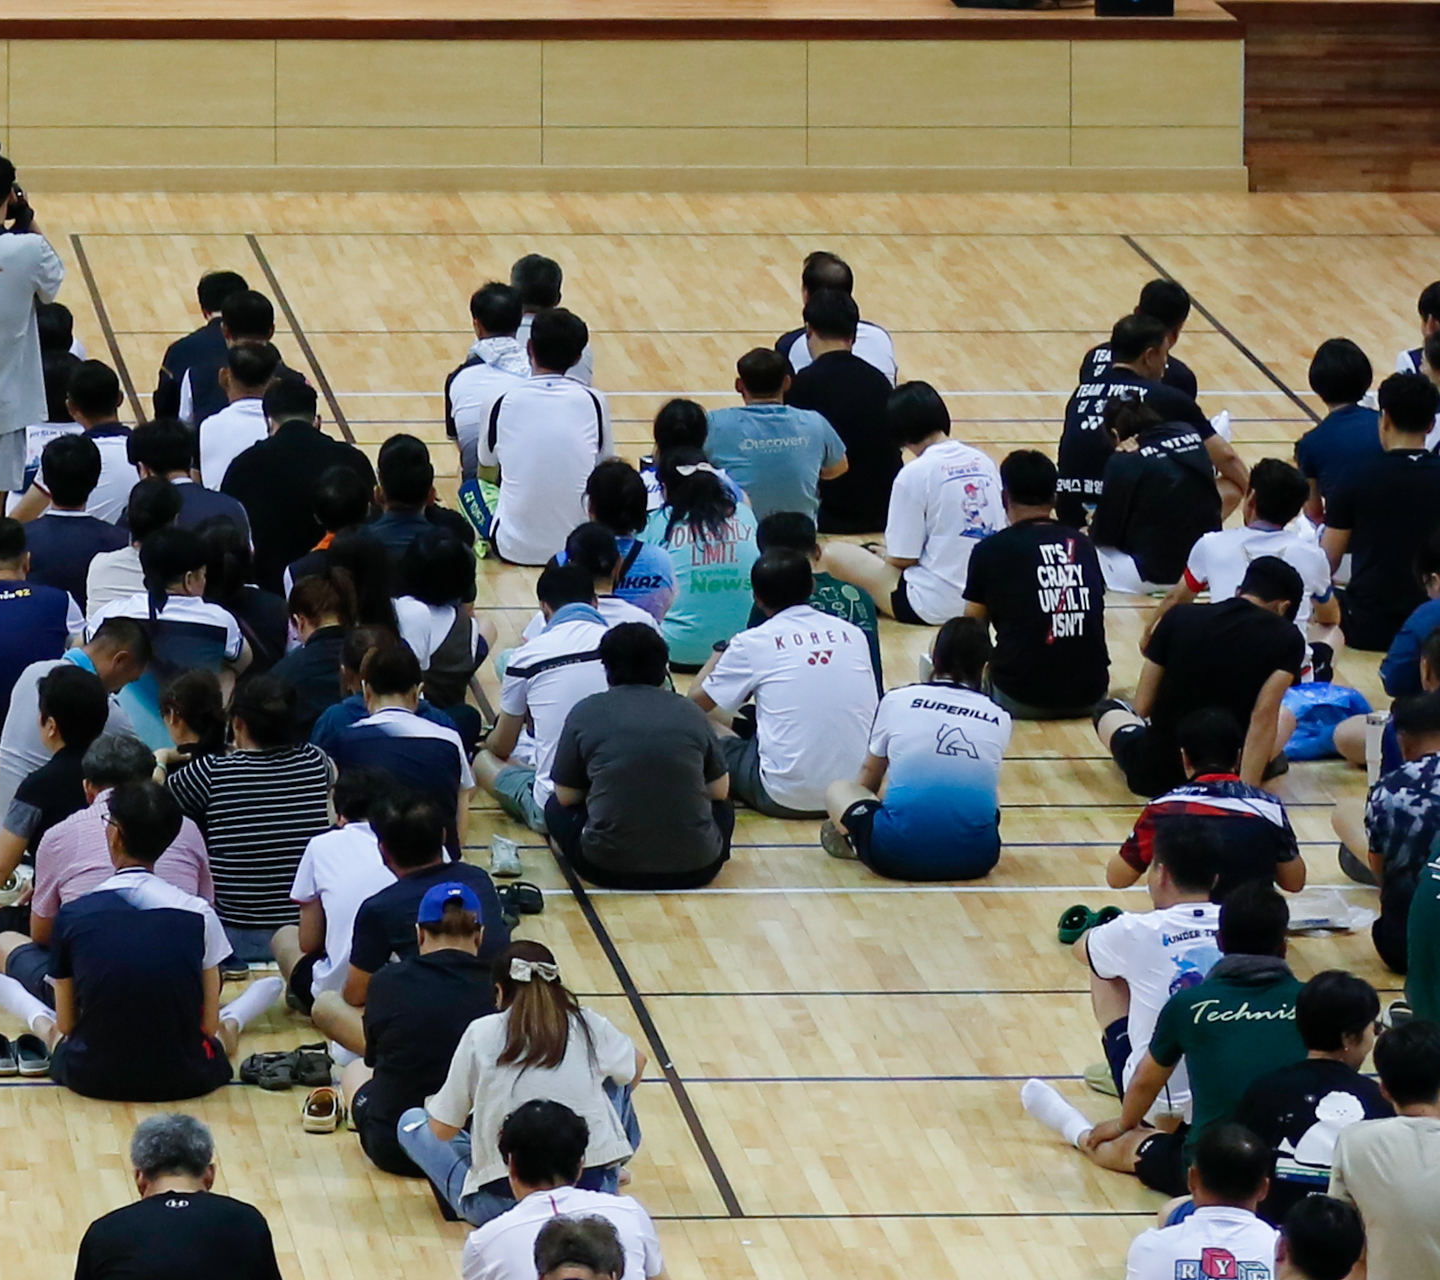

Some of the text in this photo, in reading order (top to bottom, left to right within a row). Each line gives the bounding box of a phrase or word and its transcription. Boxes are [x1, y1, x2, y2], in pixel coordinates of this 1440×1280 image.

[1092, 349, 1113, 363] TEA
[1075, 383, 1106, 399] TEAM
[742, 436, 811, 451] Discovery
[1037, 564, 1084, 588] CRAZY
[774, 629, 852, 651] KOREA
[910, 697, 1000, 727] SUPERILLA
[1168, 928, 1201, 945] UNDER
[1190, 999, 1297, 1025] Technis
